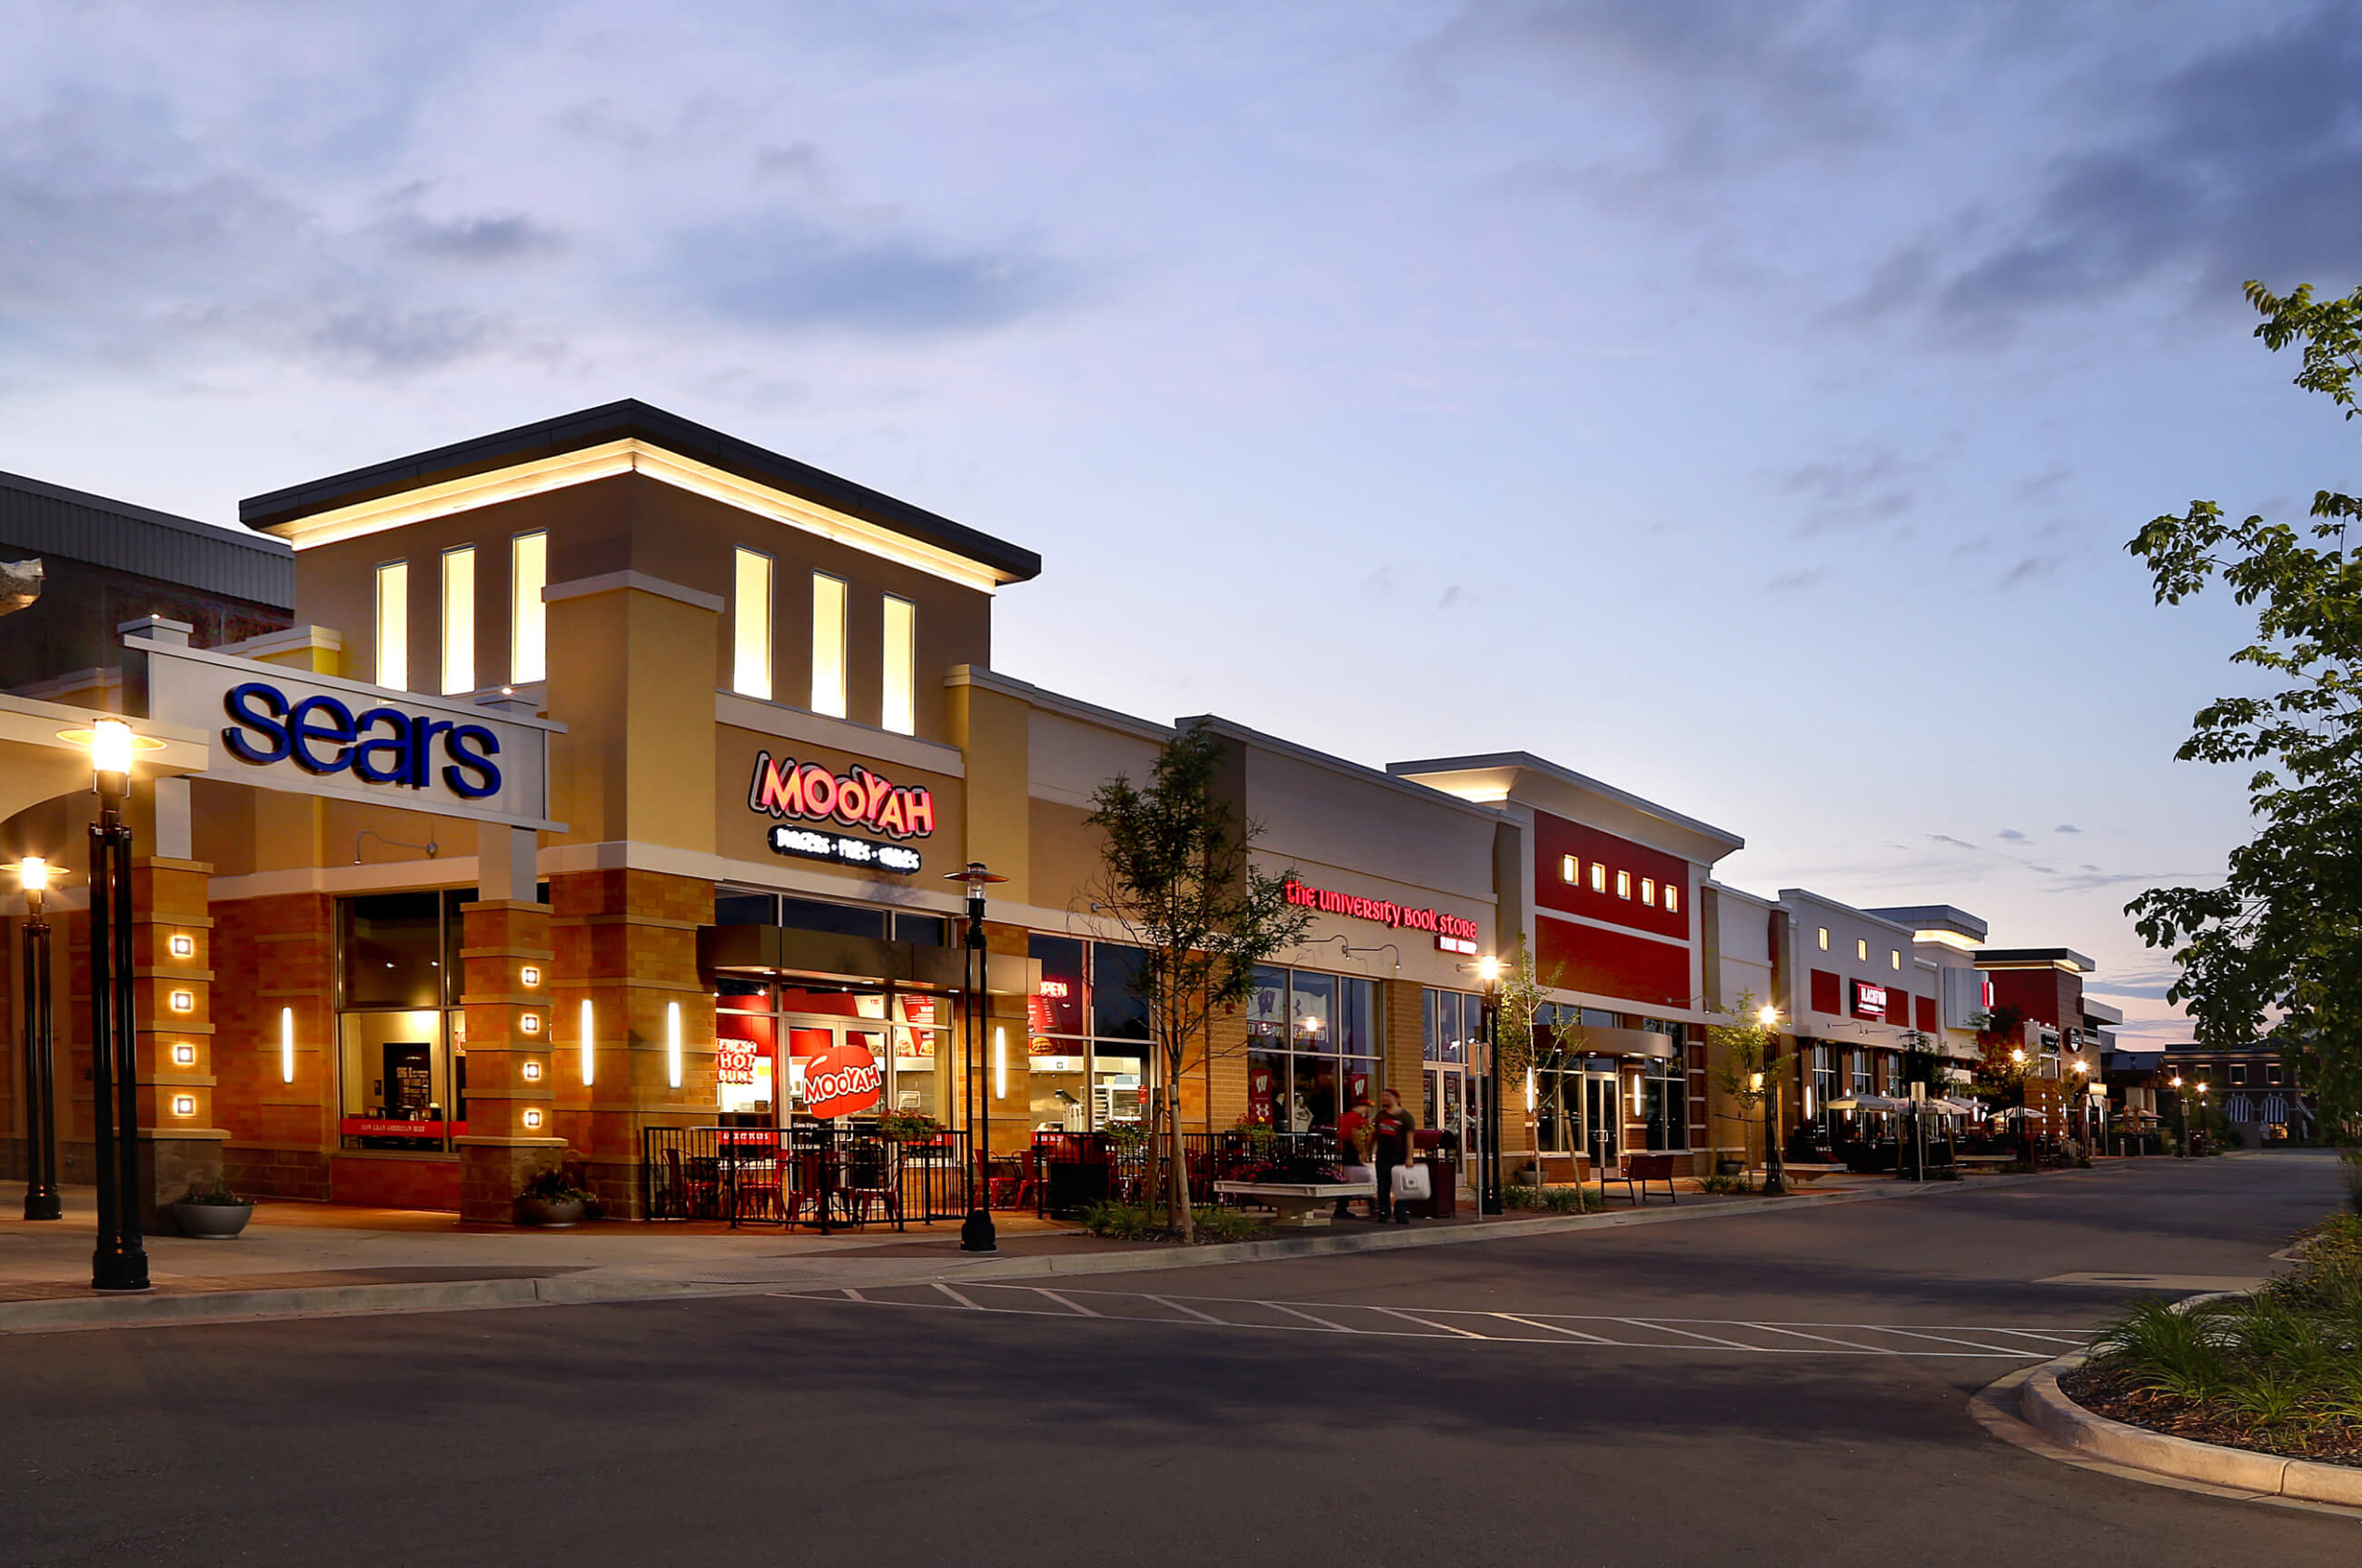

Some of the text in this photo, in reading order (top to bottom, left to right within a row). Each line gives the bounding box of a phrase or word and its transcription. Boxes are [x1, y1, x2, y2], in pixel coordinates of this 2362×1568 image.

[223, 682, 502, 799] sears
[718, 1039, 757, 1054] FRESH
[720, 1054, 755, 1069] HOT
[719, 1069, 755, 1084] BUNS
